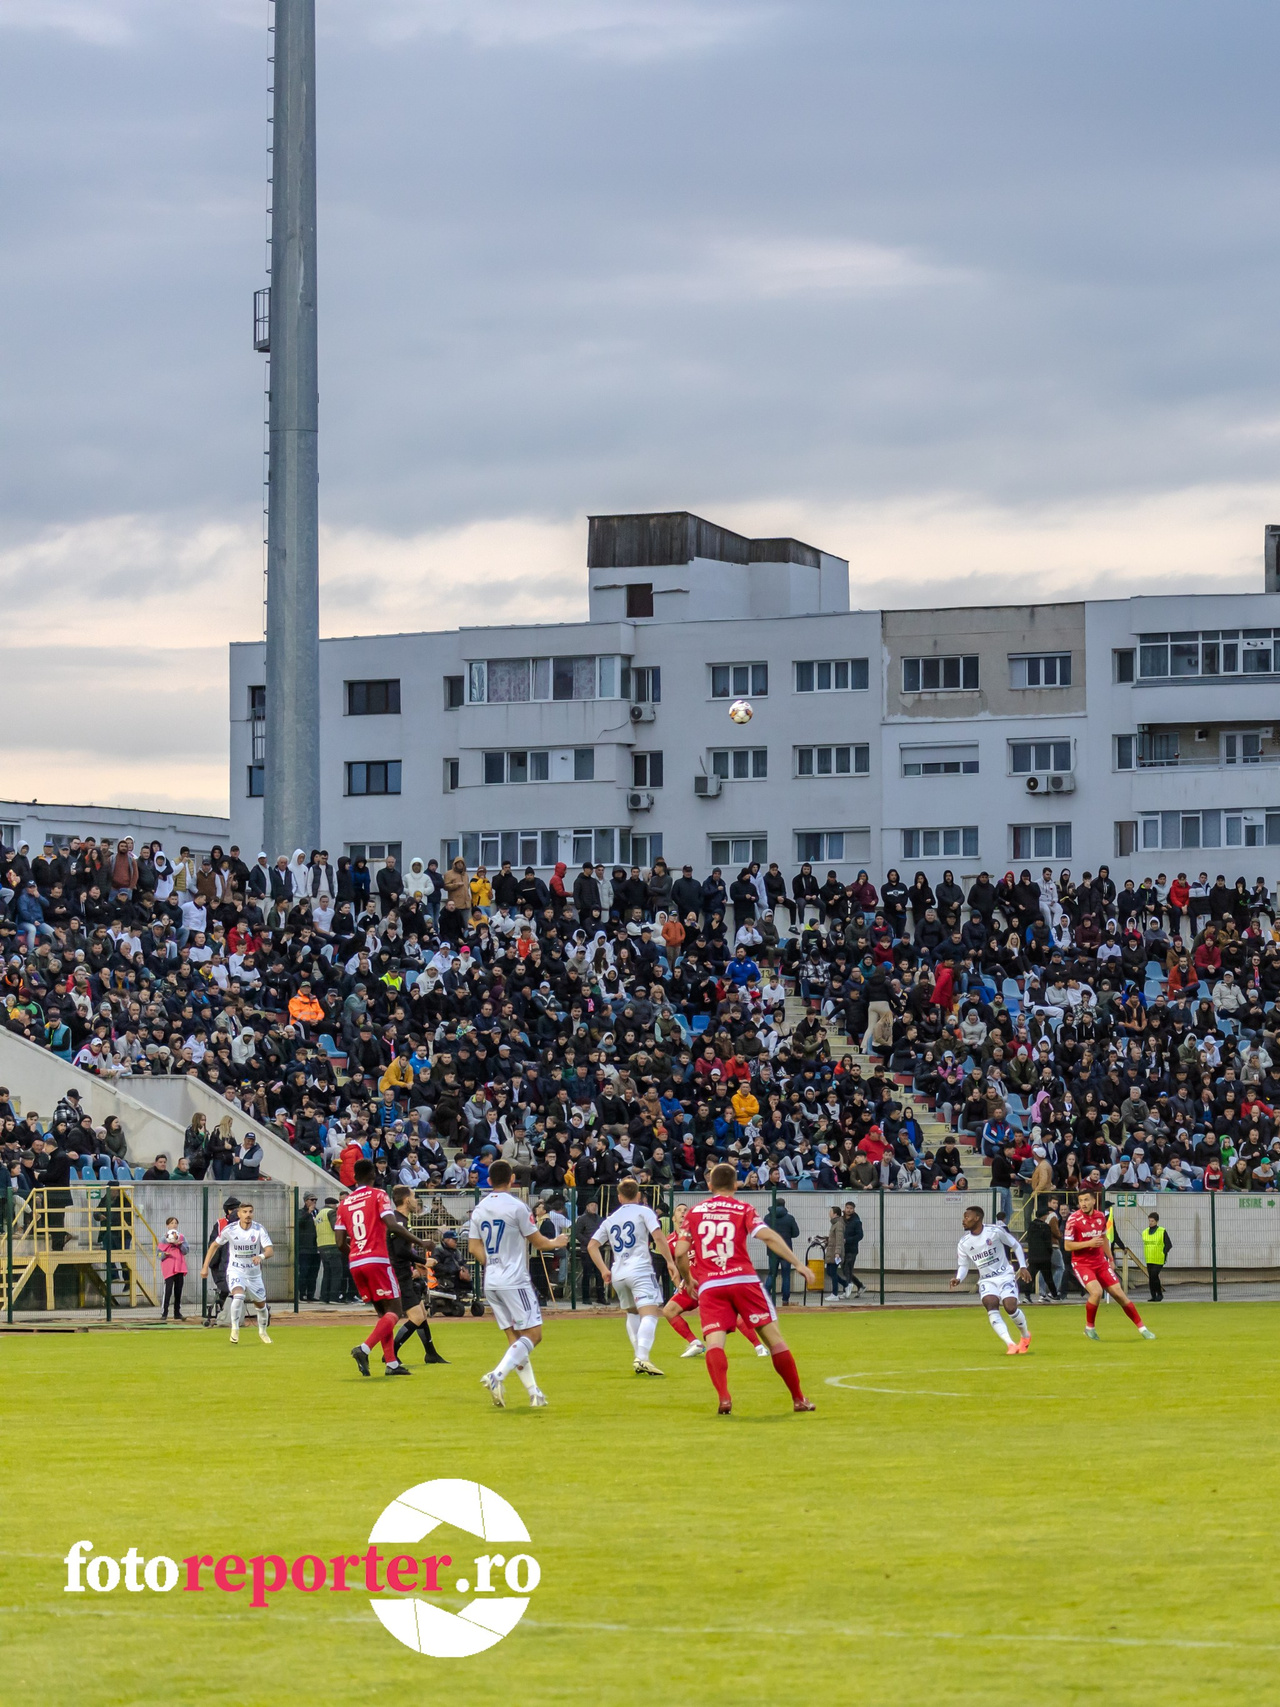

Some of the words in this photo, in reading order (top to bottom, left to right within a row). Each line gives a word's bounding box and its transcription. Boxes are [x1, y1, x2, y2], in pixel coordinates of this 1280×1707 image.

[352, 1209, 367, 1241] 8
[480, 1219, 505, 1254] 27
[610, 1220, 637, 1253] 33
[697, 1220, 736, 1260] 23
[972, 1247, 998, 1261] UNIBET
